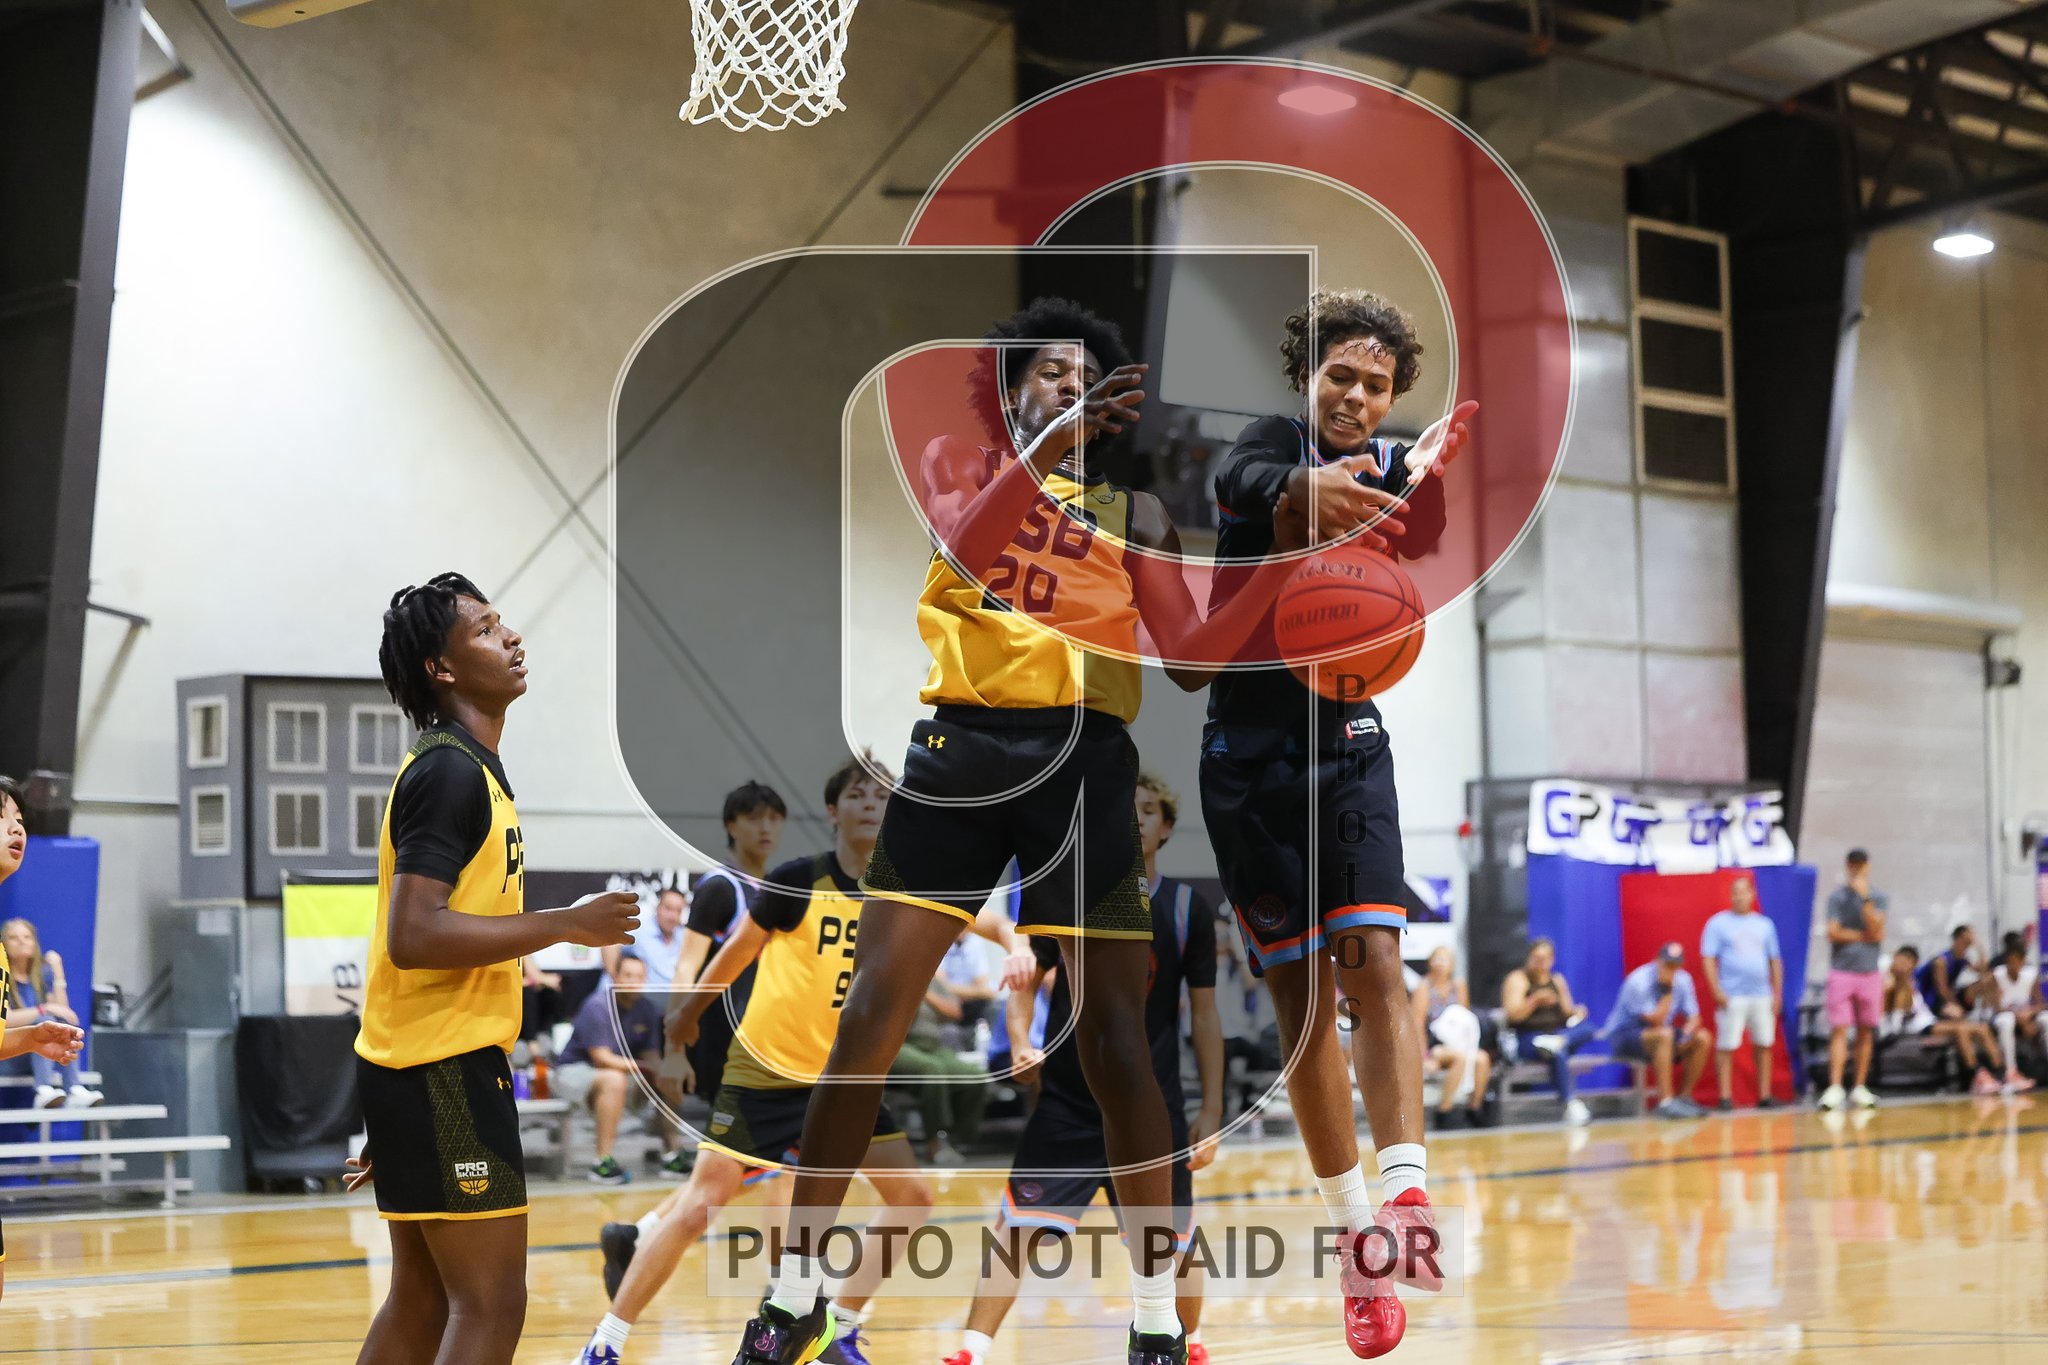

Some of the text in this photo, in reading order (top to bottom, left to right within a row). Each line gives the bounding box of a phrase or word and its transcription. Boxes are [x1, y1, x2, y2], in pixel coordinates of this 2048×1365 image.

[981, 554, 1058, 613] 20
[454, 1161, 489, 1173] PRO
[456, 1169, 490, 1178] SKILLS
